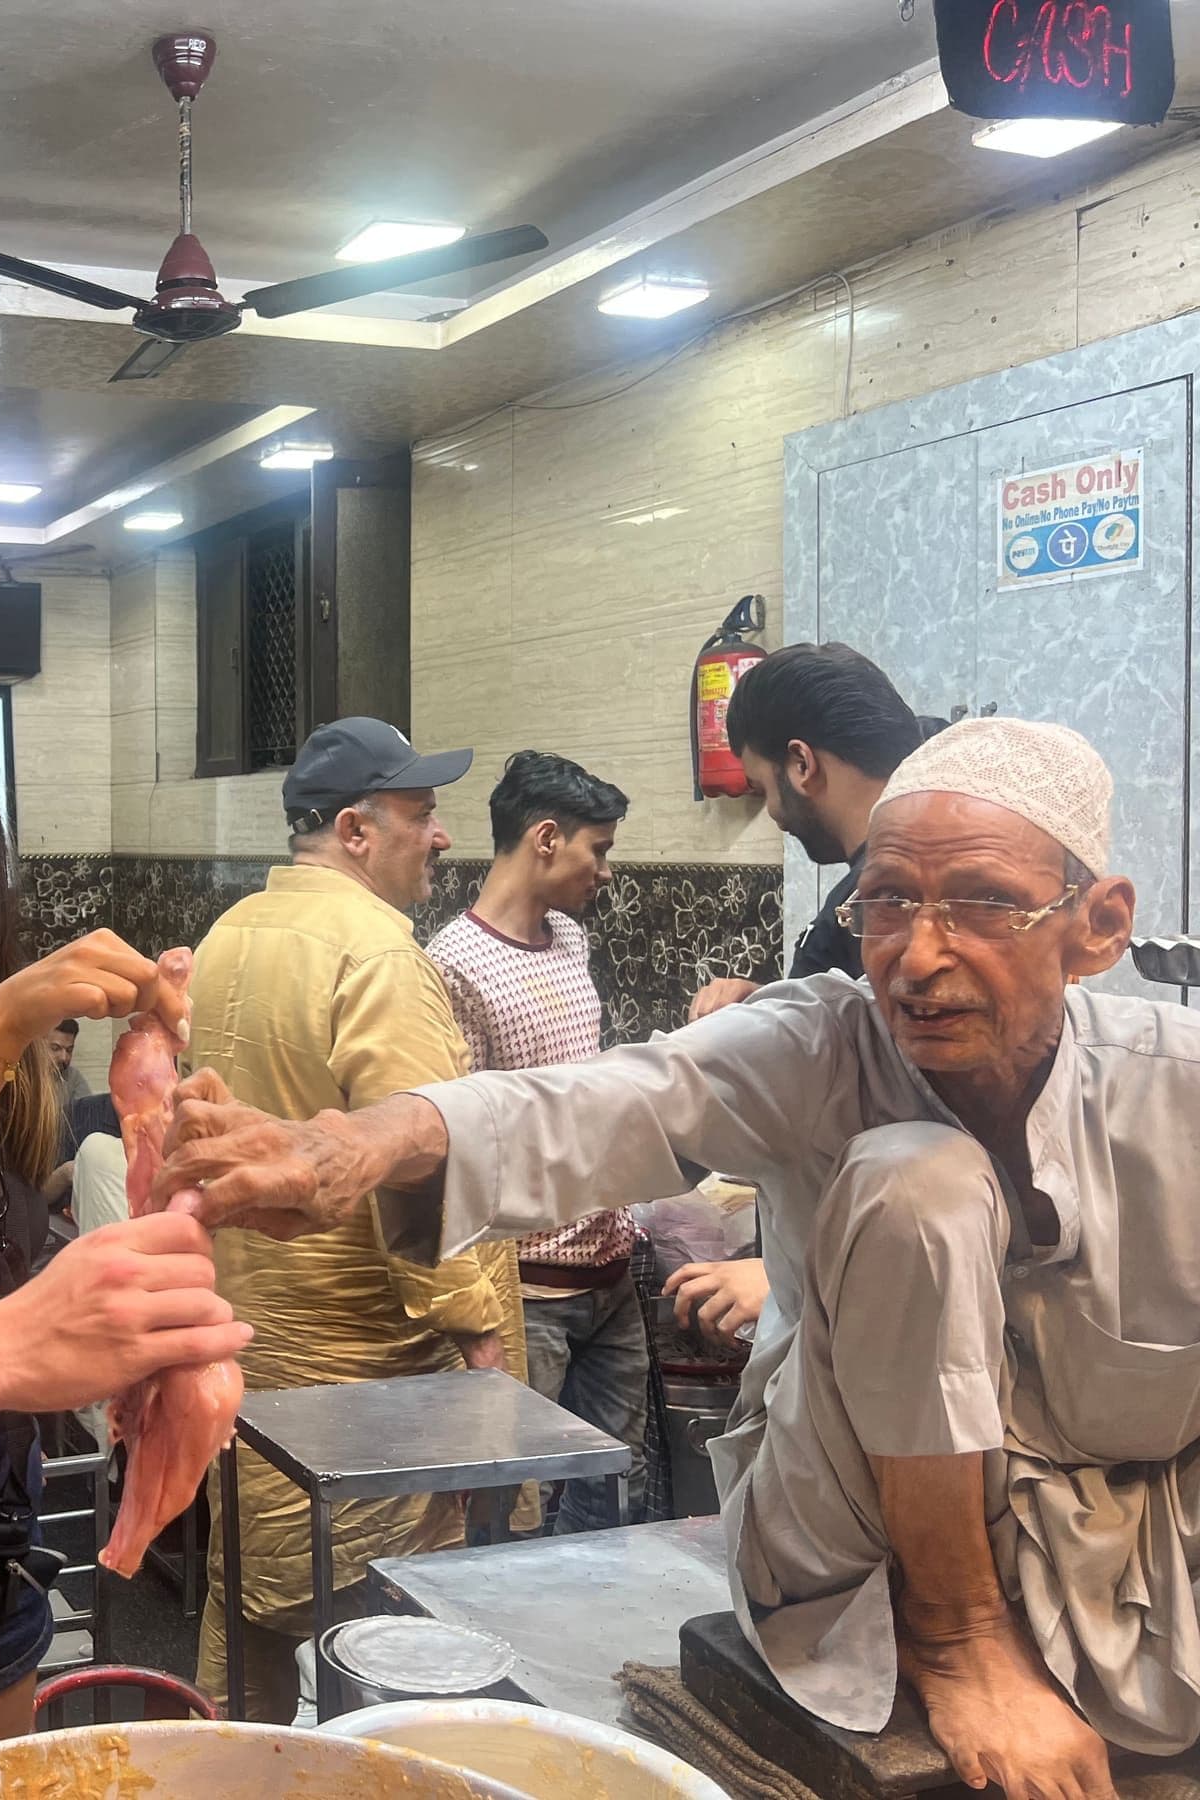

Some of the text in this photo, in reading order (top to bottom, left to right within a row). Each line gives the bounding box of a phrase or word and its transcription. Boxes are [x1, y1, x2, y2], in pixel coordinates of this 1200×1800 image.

[983, 0, 1132, 96] CASH
[1003, 460, 1139, 510] Cash Only
[1053, 506, 1079, 520] Phone
[1112, 495, 1139, 510] Paytm
